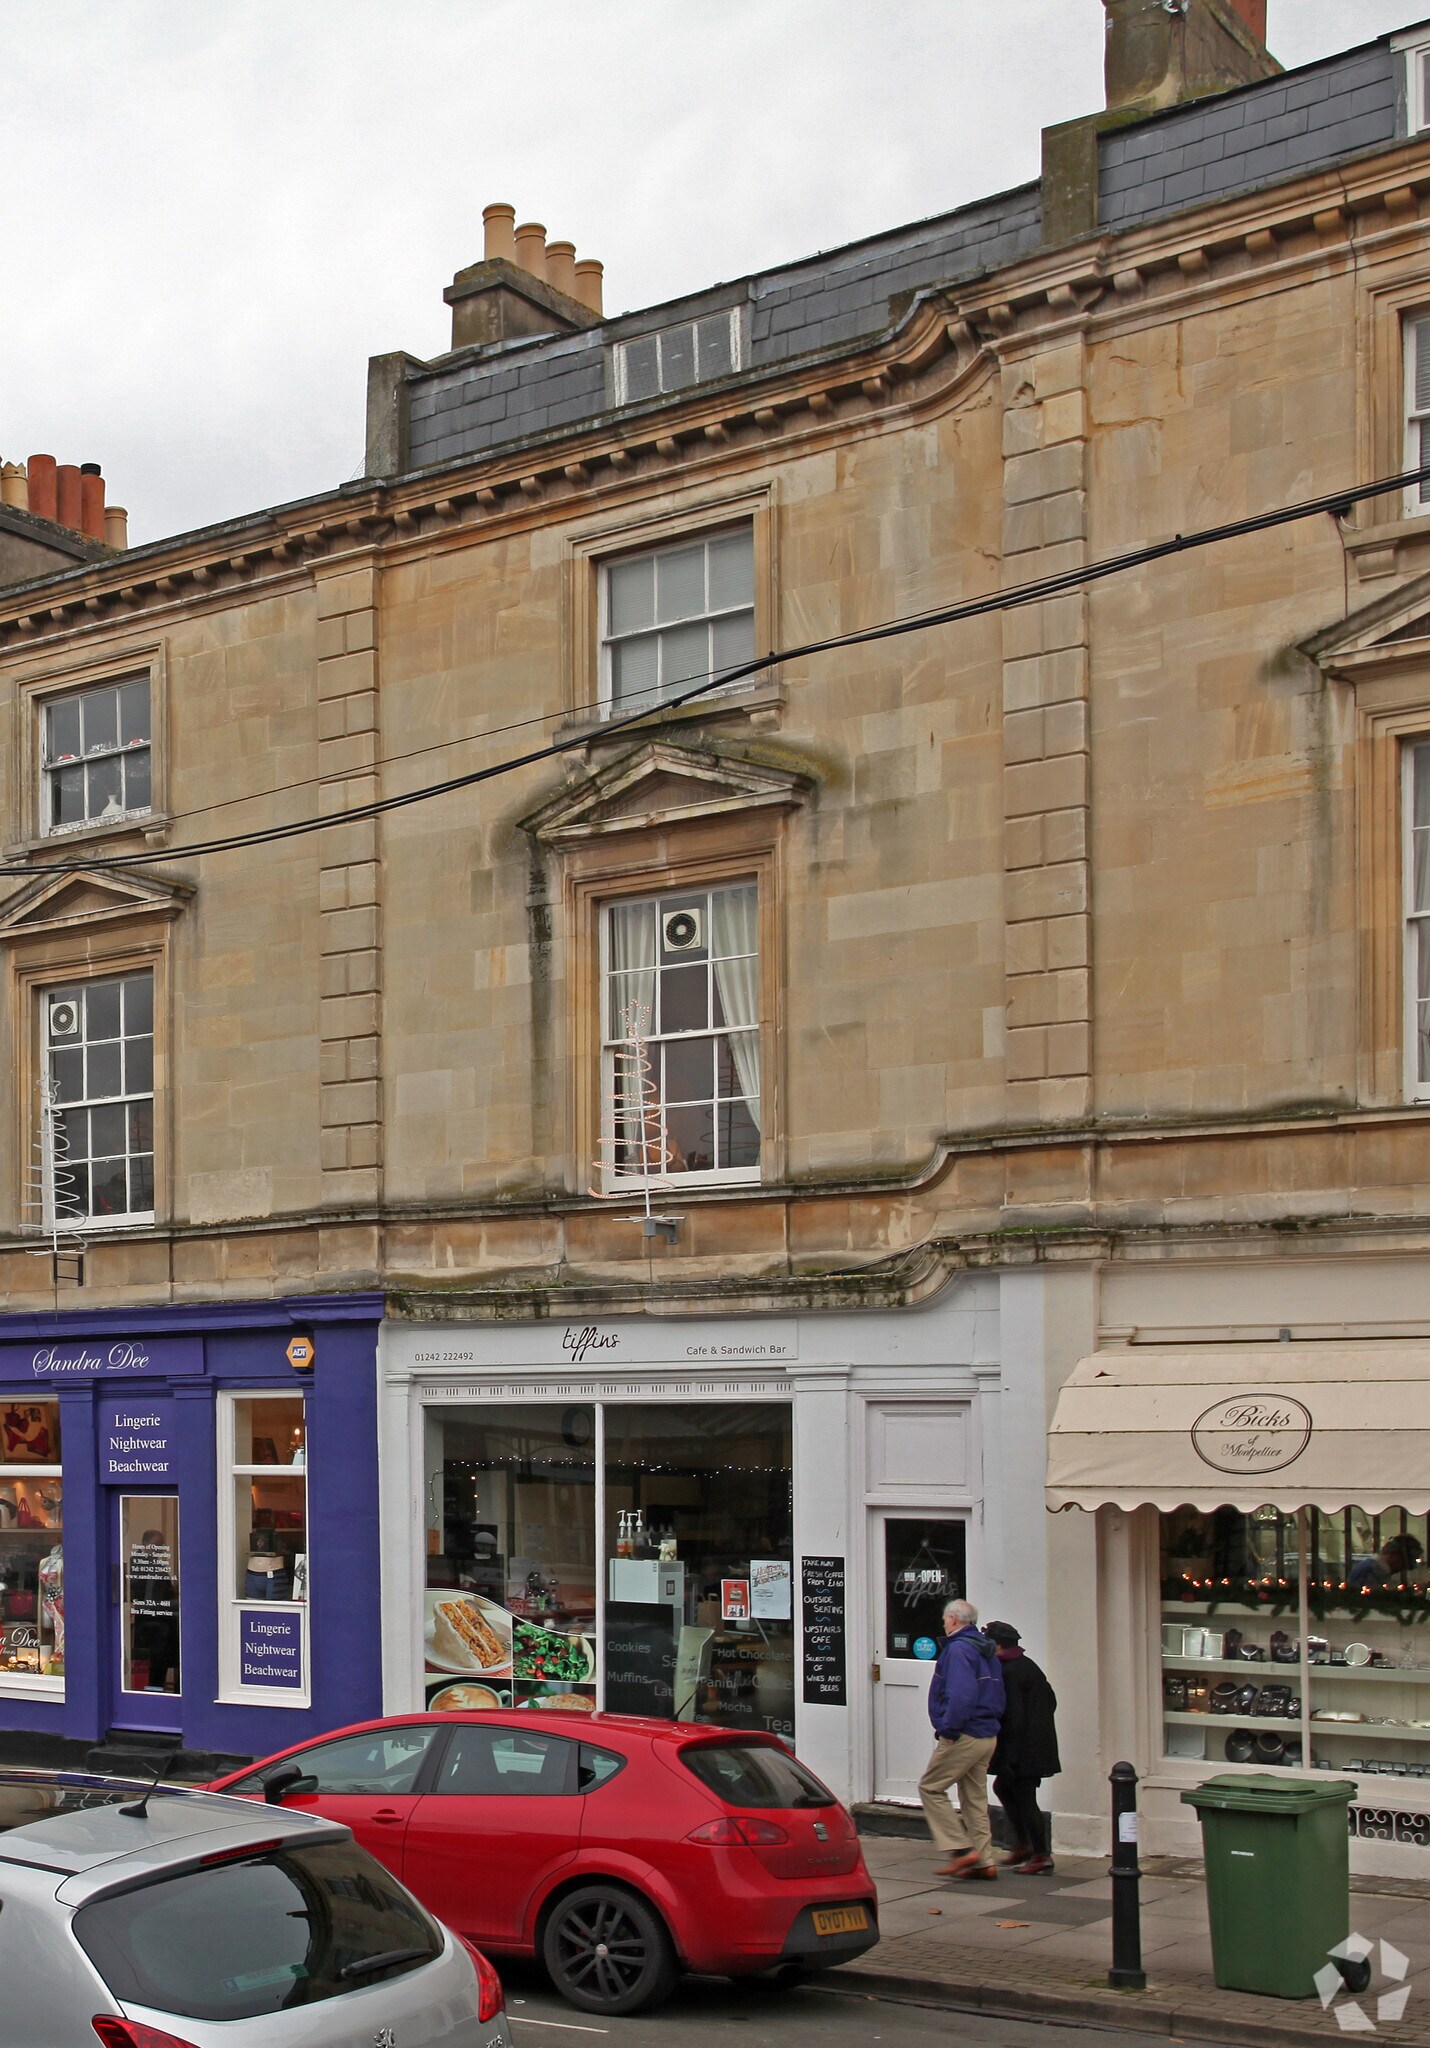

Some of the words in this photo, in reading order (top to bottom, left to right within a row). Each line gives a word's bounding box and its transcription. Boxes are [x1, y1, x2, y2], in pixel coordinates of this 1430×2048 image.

[562, 1327, 620, 1361] tiffins
[686, 1346, 707, 1355] Cafe
[711, 1346, 718, 1355] &
[721, 1345, 766, 1354] Sandwich
[769, 1345, 787, 1354] Bar
[32, 1346, 102, 1377] Sandra
[106, 1342, 149, 1370] Dee
[415, 1352, 439, 1361] 01242
[443, 1352, 474, 1361] 222492
[115, 1413, 161, 1430] Lingerie
[1220, 1404, 1291, 1427] Bicks
[109, 1436, 167, 1453] Nightwear
[1247, 1435, 1260, 1446] of
[1221, 1444, 1282, 1461] Montpellier
[109, 1459, 169, 1472] Beachwear
[250, 1621, 291, 1637] Lingerie
[804, 1625, 841, 1634] UPSTAIRS
[10, 1627, 40, 1648] Dee
[811, 1635, 831, 1644] CAFE
[245, 1642, 296, 1657] Nightwear
[607, 1641, 651, 1653] Cookies
[718, 1648, 736, 1658] Hot
[740, 1650, 792, 1661] Chocolate
[244, 1663, 298, 1678] Beachwear
[607, 1671, 648, 1684] Muffins
[719, 1702, 752, 1713] Mocha
[762, 1715, 792, 1732] Tea
